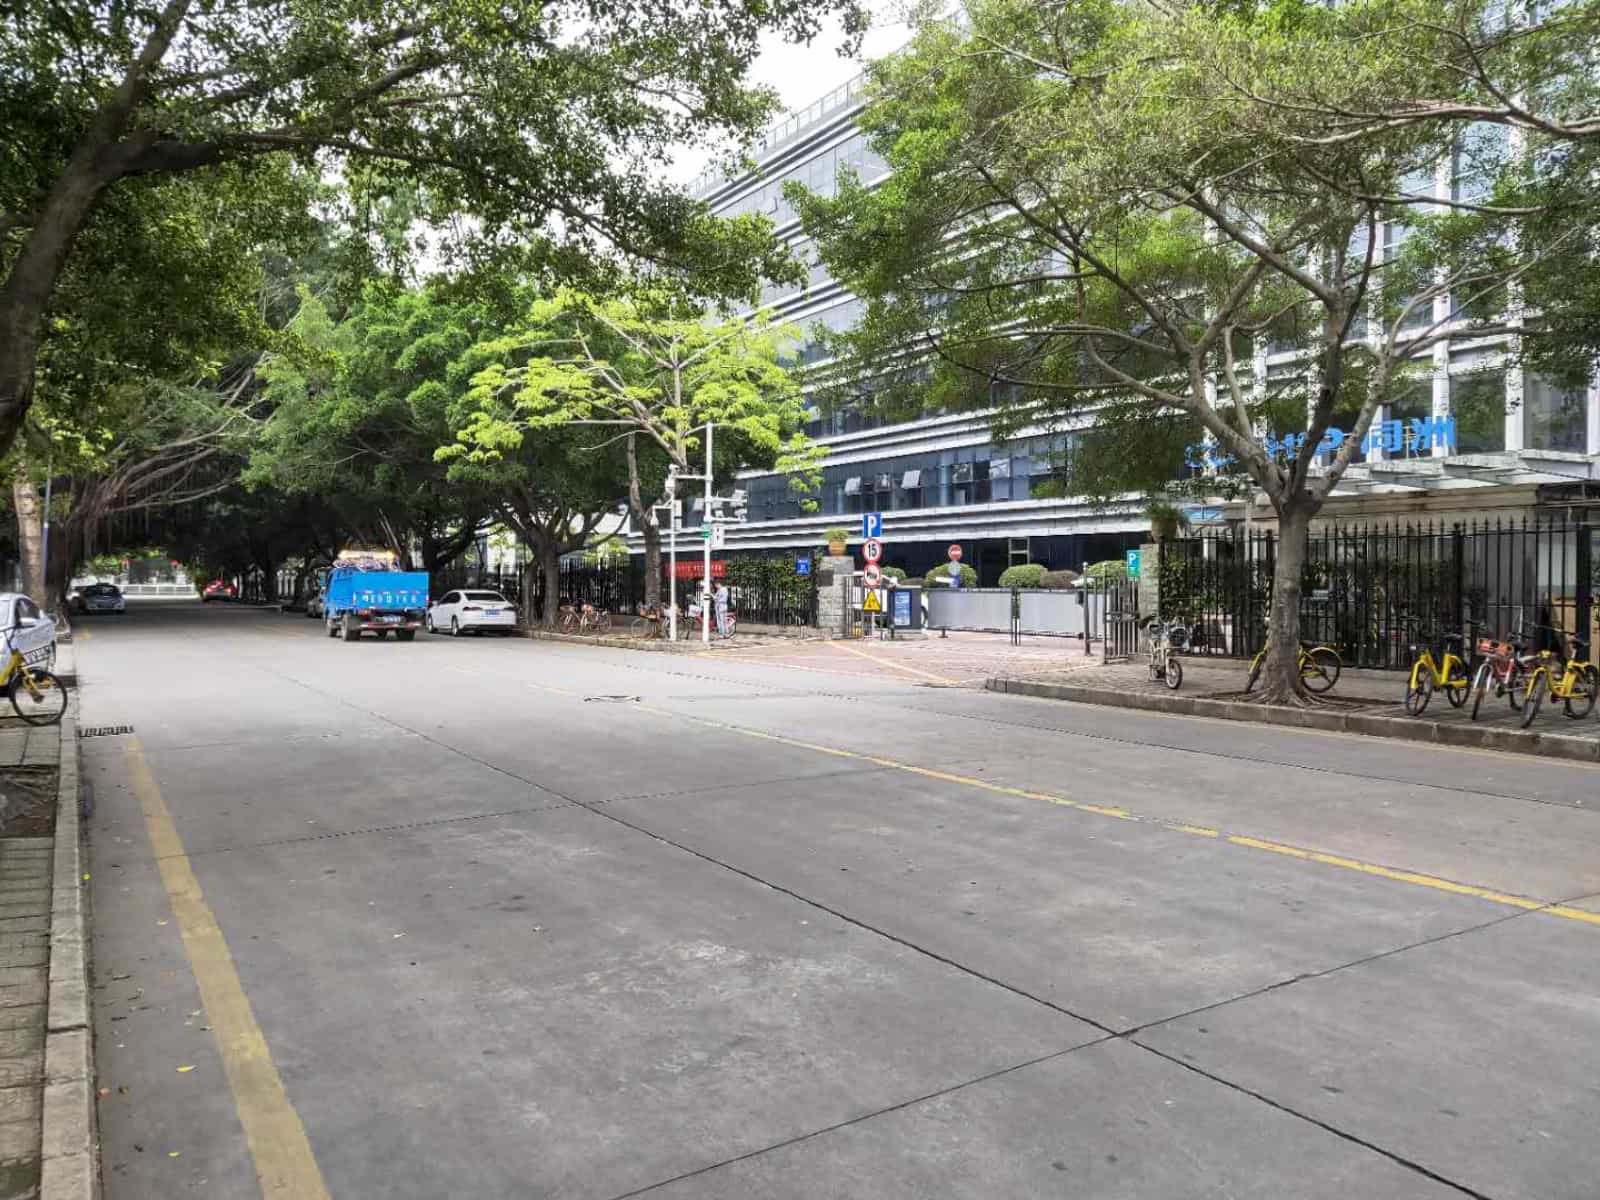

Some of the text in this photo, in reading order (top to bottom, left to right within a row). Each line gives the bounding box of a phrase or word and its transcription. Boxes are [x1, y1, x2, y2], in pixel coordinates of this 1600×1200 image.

[868, 515, 878, 537] P
[868, 543, 878, 558] 15
[1128, 552, 1137, 566] P
